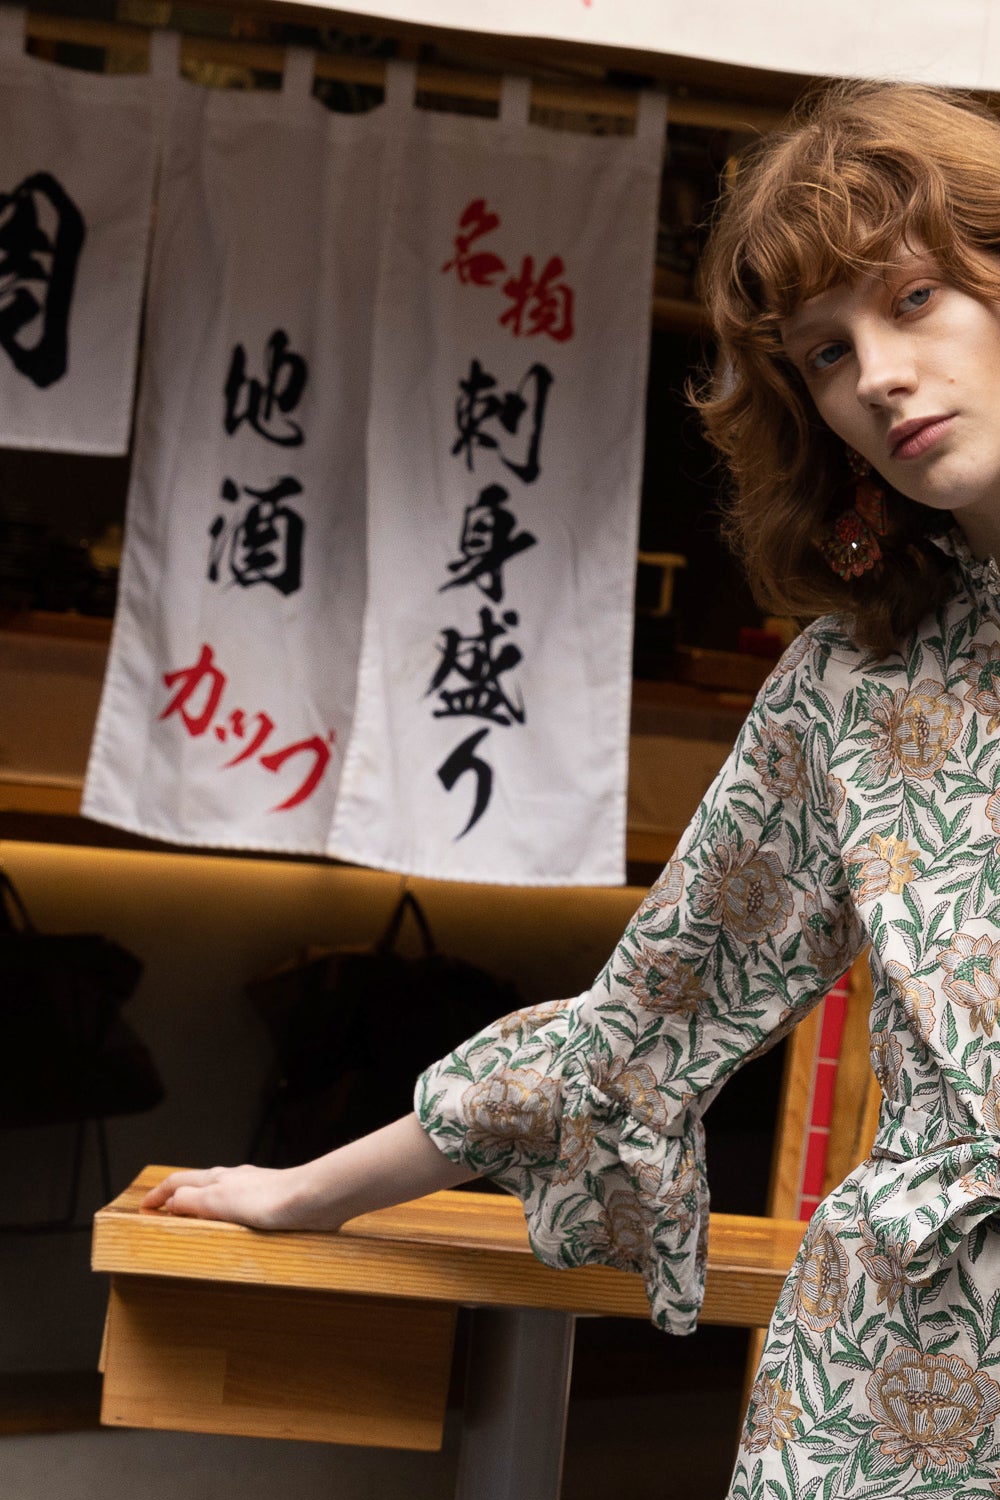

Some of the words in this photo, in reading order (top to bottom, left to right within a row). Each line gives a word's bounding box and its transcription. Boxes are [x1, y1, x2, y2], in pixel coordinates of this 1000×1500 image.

[442, 198, 575, 342] 名物
[208, 329, 308, 596] 地酒
[425, 360, 553, 842] 刺身盛り
